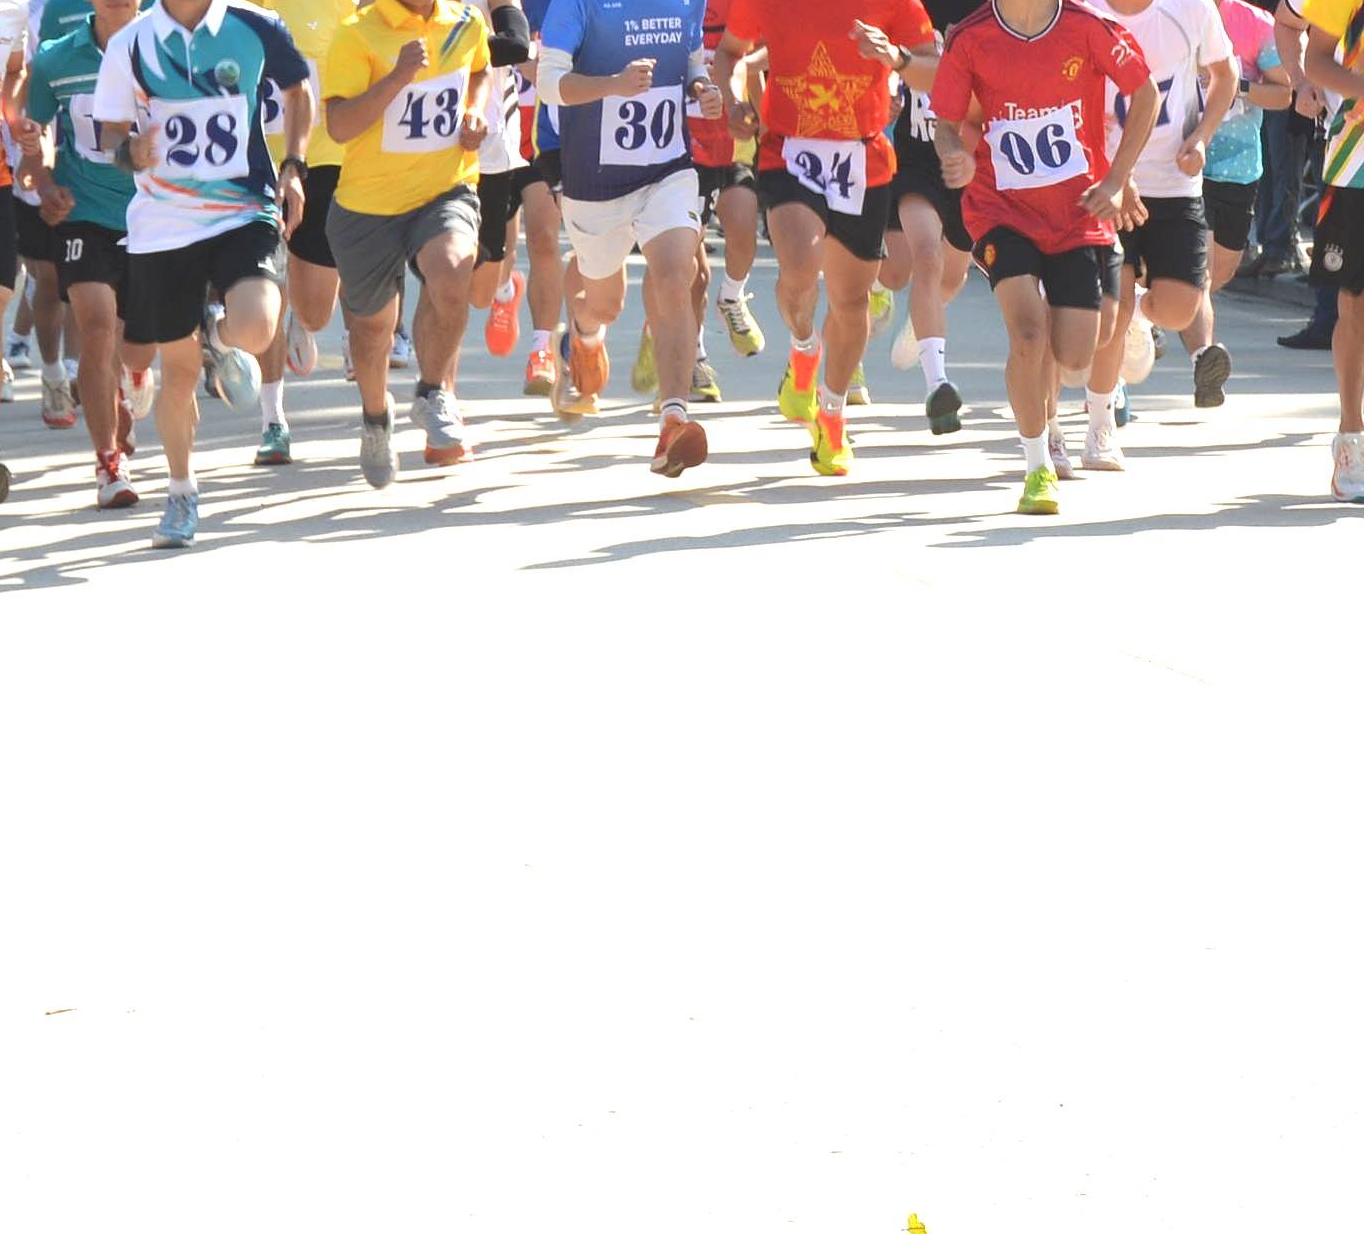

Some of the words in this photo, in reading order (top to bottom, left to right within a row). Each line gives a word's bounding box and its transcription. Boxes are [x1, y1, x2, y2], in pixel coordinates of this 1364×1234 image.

[624, 31, 683, 47] EVERYDAY
[641, 16, 682, 31] BETTER
[397, 88, 459, 140] 43
[614, 99, 676, 150] 30
[165, 113, 238, 167] 28
[1000, 123, 1072, 175] 06
[795, 151, 855, 199] 24
[65, 237, 84, 263] 10
